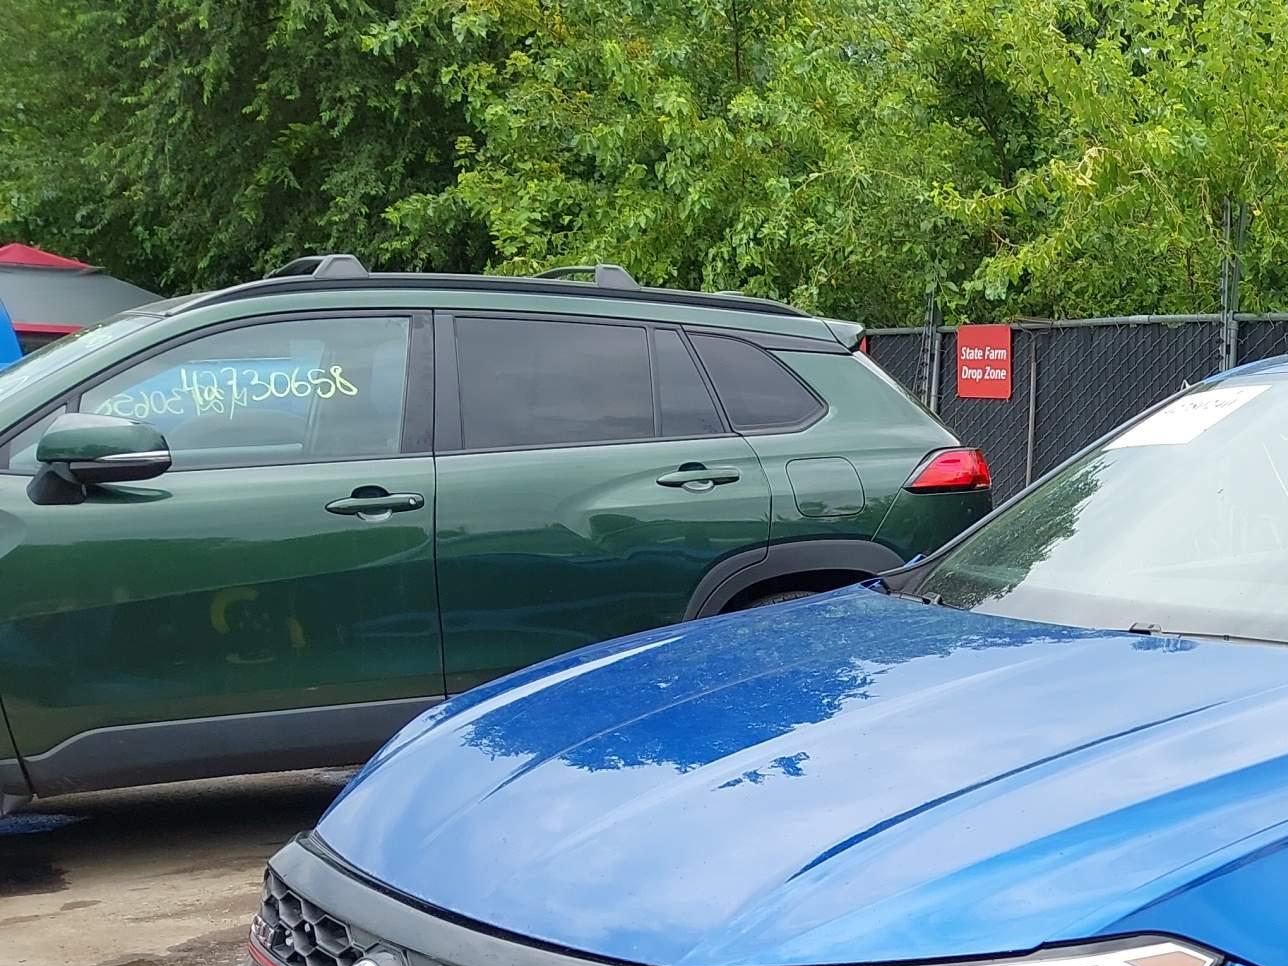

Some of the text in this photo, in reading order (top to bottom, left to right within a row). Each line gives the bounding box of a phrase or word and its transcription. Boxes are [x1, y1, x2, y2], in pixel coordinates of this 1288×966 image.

[960, 346, 1007, 360] State Farm
[961, 365, 1007, 382] Drop Zone
[180, 365, 359, 404] 42730658
